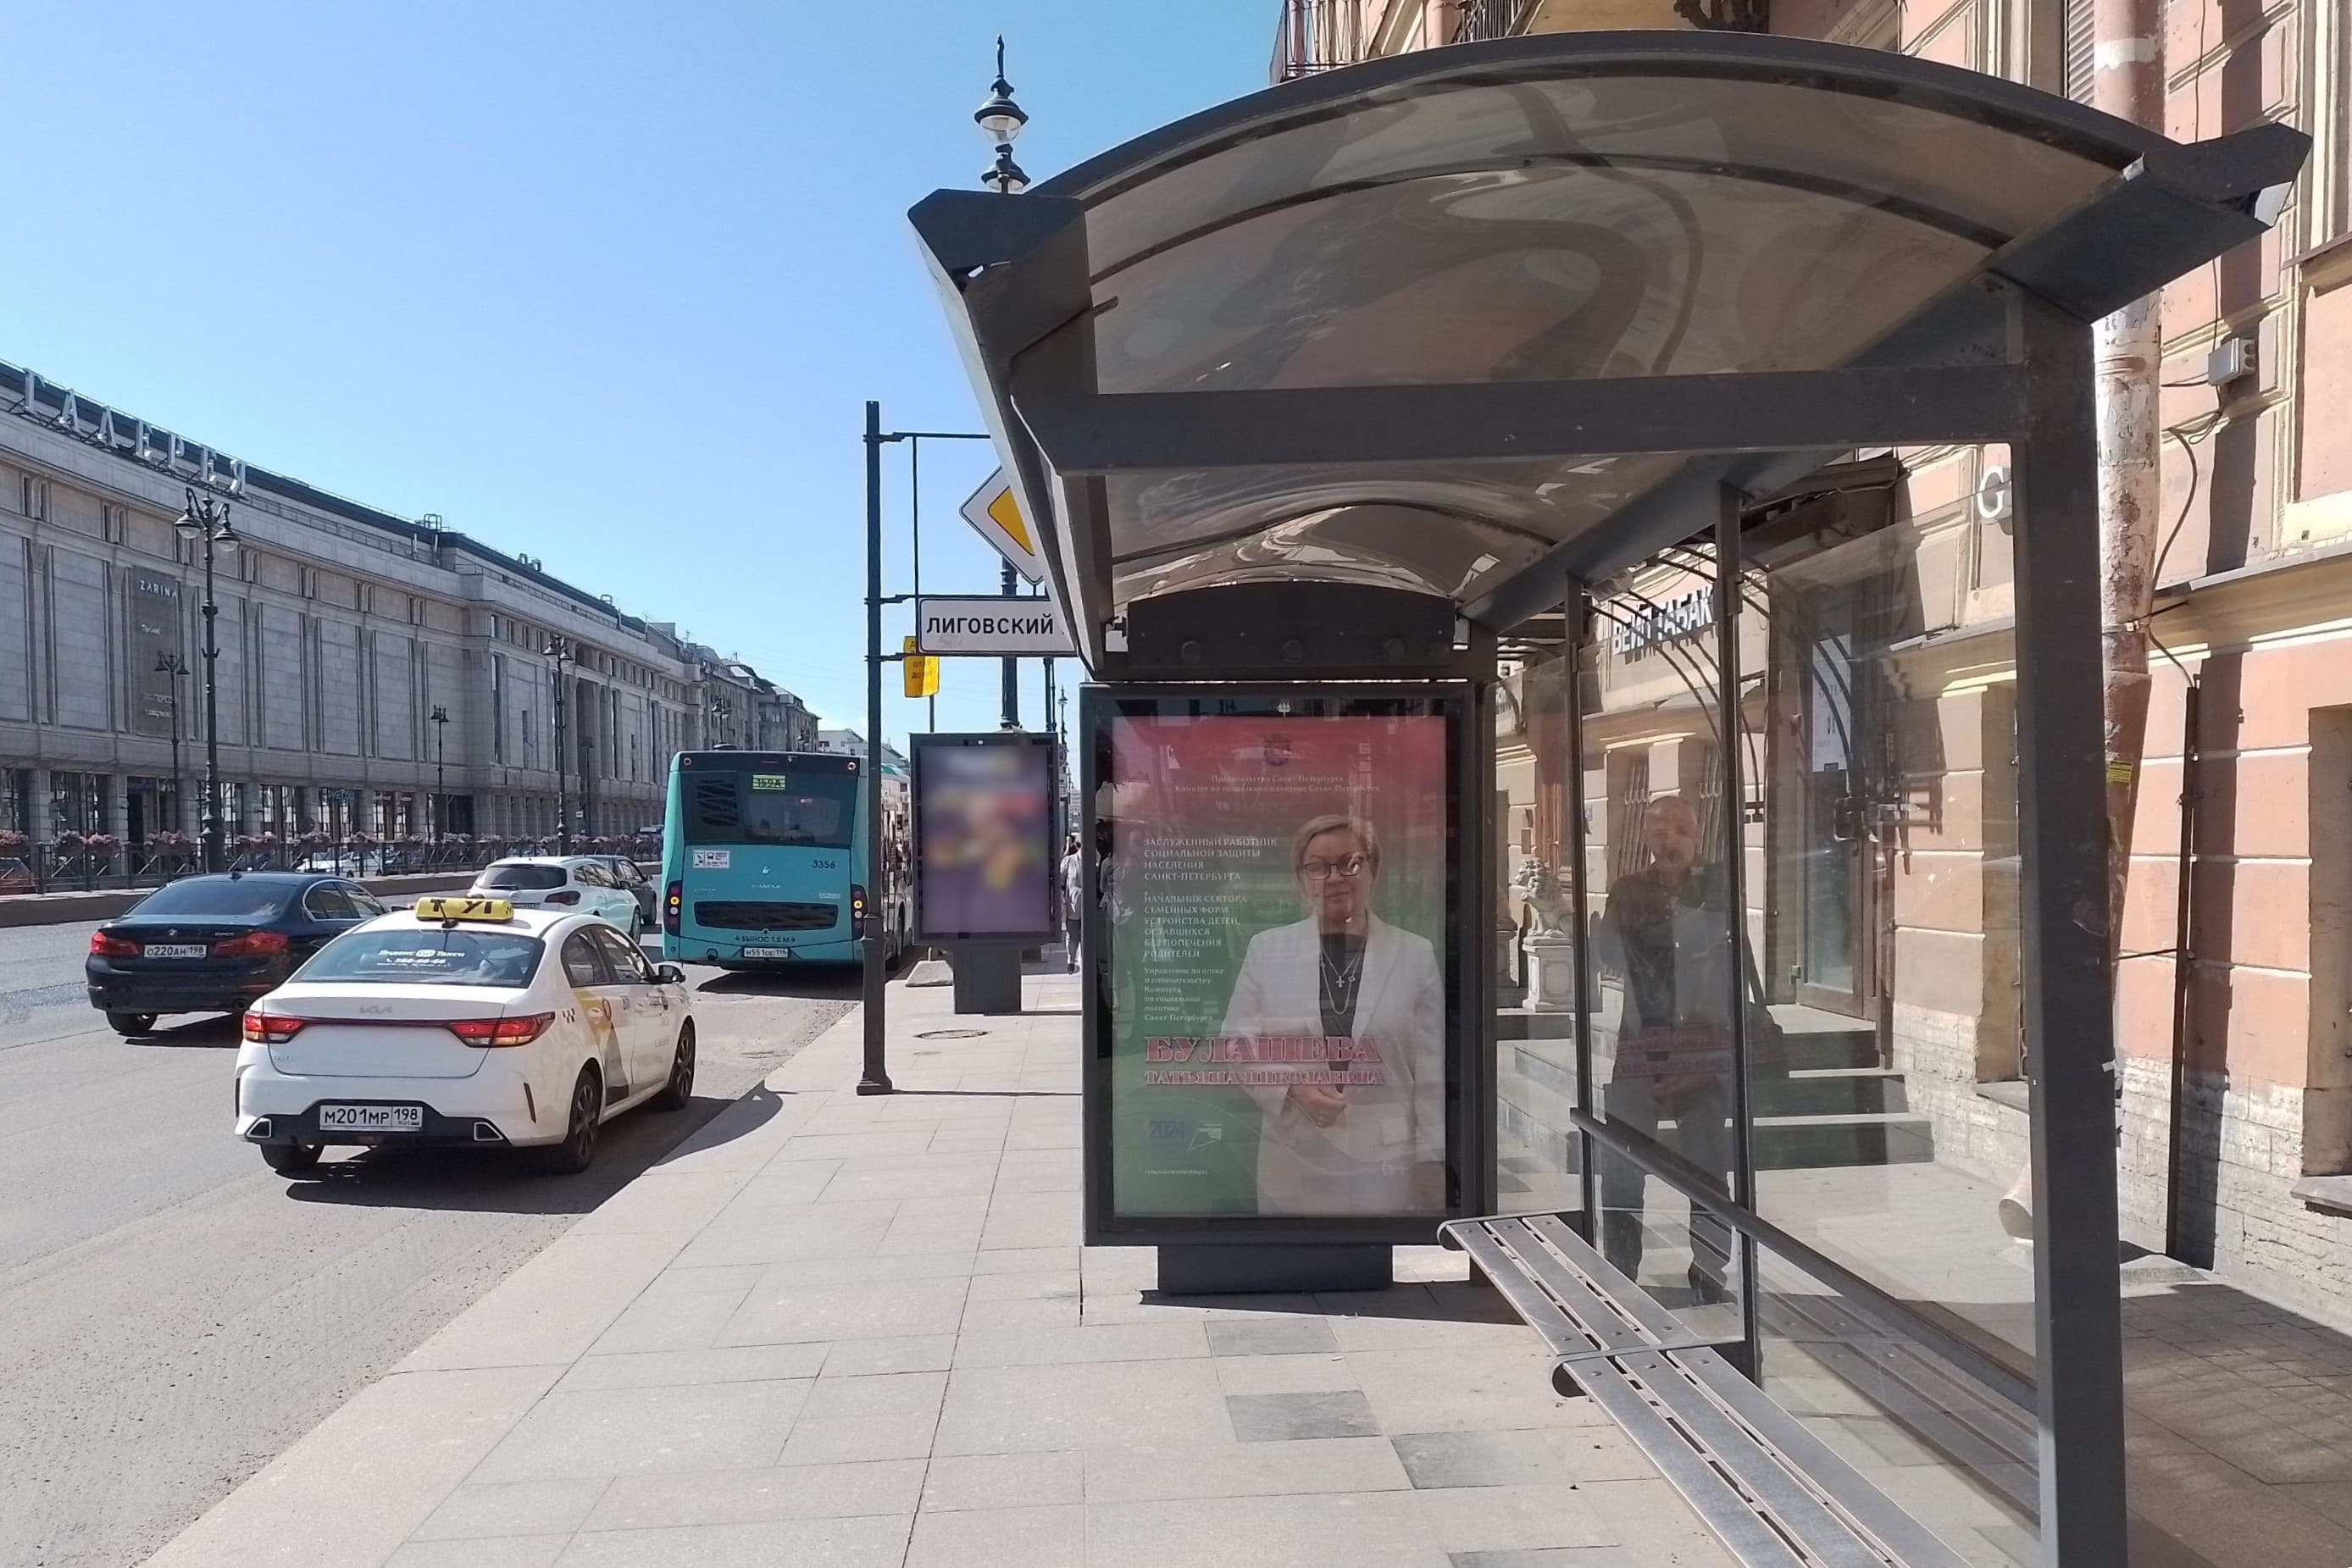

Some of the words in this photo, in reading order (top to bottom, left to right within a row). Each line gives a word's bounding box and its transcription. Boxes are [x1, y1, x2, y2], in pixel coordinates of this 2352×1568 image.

[23, 368, 249, 495] ГАЛЕРЕЯ
[141, 580, 178, 597] ZARINA
[926, 612, 1053, 634] ЛИГОВСКИЙ
[1223, 838, 1278, 846] РАБОТНИК
[1217, 850, 1261, 858] ЗАЩИТЫ
[813, 860, 835, 869] 3356
[1145, 861, 1205, 869] НАСЕЛЕНИЯ
[1144, 873, 1241, 881] САНКТ-ПЕТЕРБУРГА
[1145, 895, 1202, 903] НАЧАЛЬНИК
[1204, 895, 1247, 903] СЕКТОРА
[1200, 906, 1229, 914] ФОРМ
[1165, 939, 1222, 947] ПОПЕЧЕНИЯ
[147, 946, 186, 956] О220АН
[1145, 1036, 1382, 1063] БУЛАШЕВА
[1144, 1070, 1240, 1085] ТАТЬЯНА
[1243, 1070, 1384, 1085] НИКОЛАЕВНА
[325, 1108, 390, 1125] М201МР
[394, 1108, 418, 1120] 198
